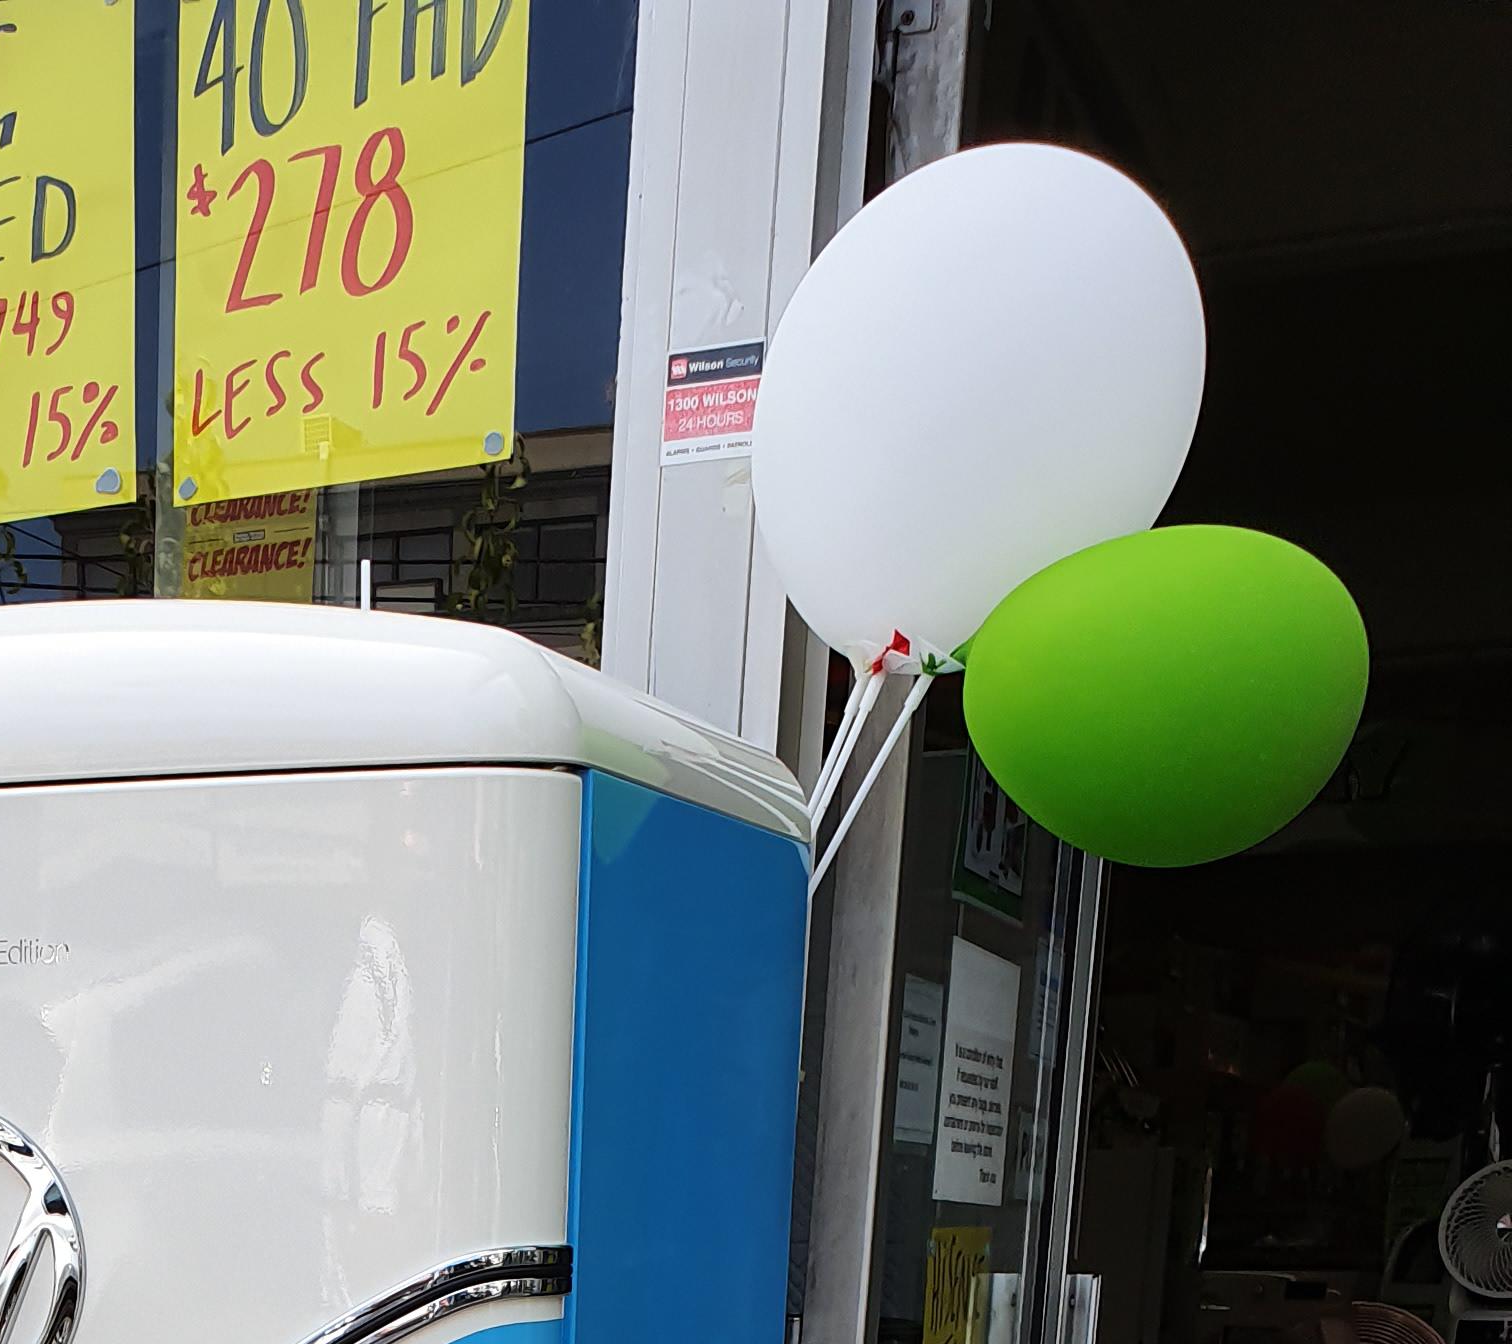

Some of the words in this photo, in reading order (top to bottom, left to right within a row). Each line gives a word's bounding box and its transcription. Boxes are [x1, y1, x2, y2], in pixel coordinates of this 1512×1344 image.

[194, 0, 309, 156] 40
[186, 127, 413, 316] $278
[190, 350, 326, 441] LESS
[371, 311, 492, 417] 15%
[688, 359, 724, 374] Wilson
[21, 381, 120, 469] 15%
[668, 395, 699, 412] 1300
[702, 388, 757, 408] WILSON
[678, 417, 694, 432] 24
[696, 410, 744, 429] HOURS
[187, 537, 313, 582] CLEARANCE!
